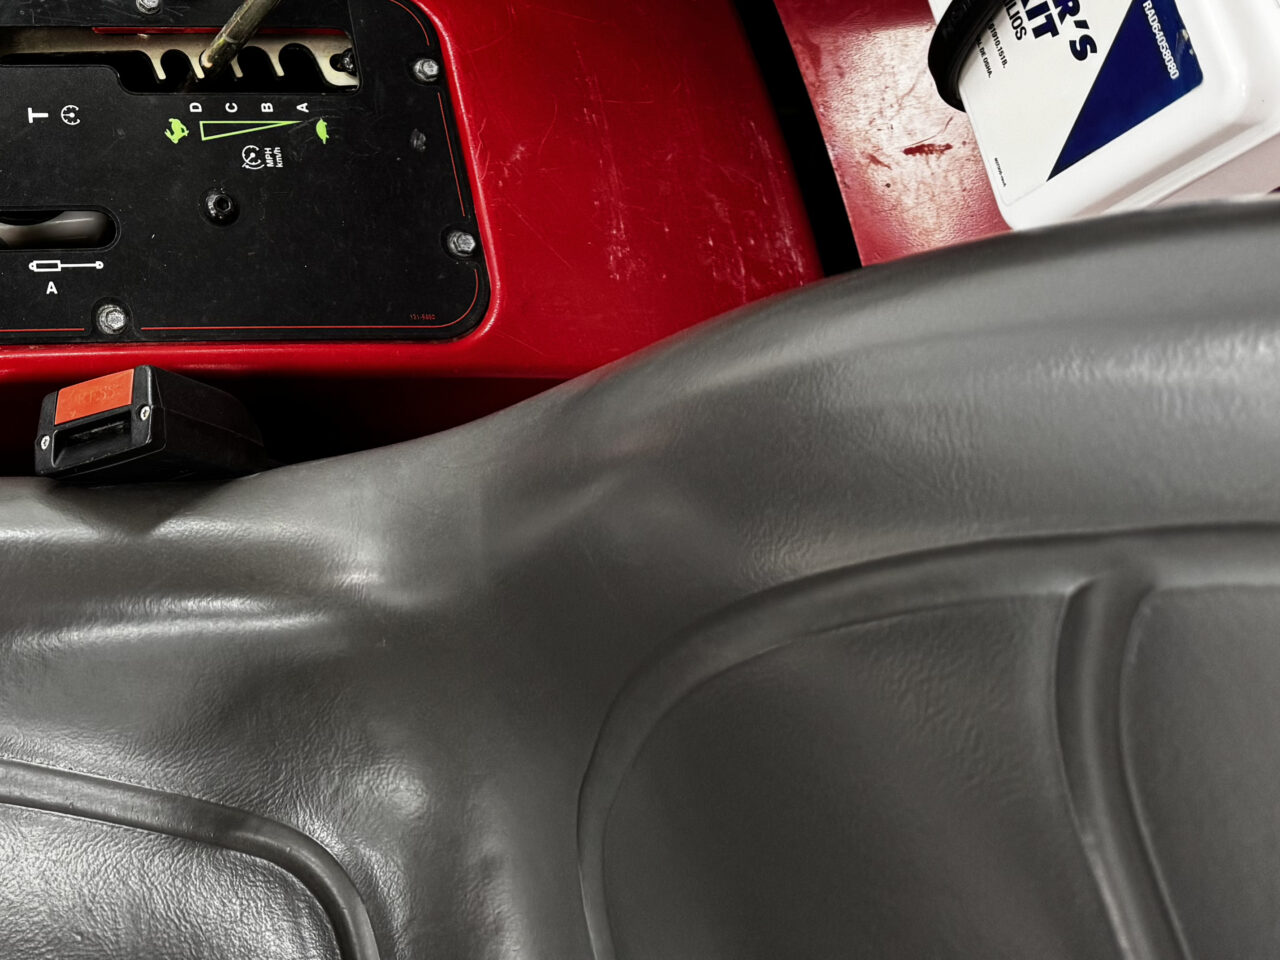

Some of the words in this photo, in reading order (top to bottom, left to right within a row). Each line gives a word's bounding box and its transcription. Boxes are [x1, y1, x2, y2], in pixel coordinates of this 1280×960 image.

[1143, 0, 1179, 79] RAD64058080
[190, 102, 202, 112] D
[225, 103, 237, 112] C
[261, 103, 273, 112] B
[296, 103, 309, 112] A
[265, 148, 274, 167] MPH
[274, 147, 283, 167] km/h
[46, 281, 57, 294] A
